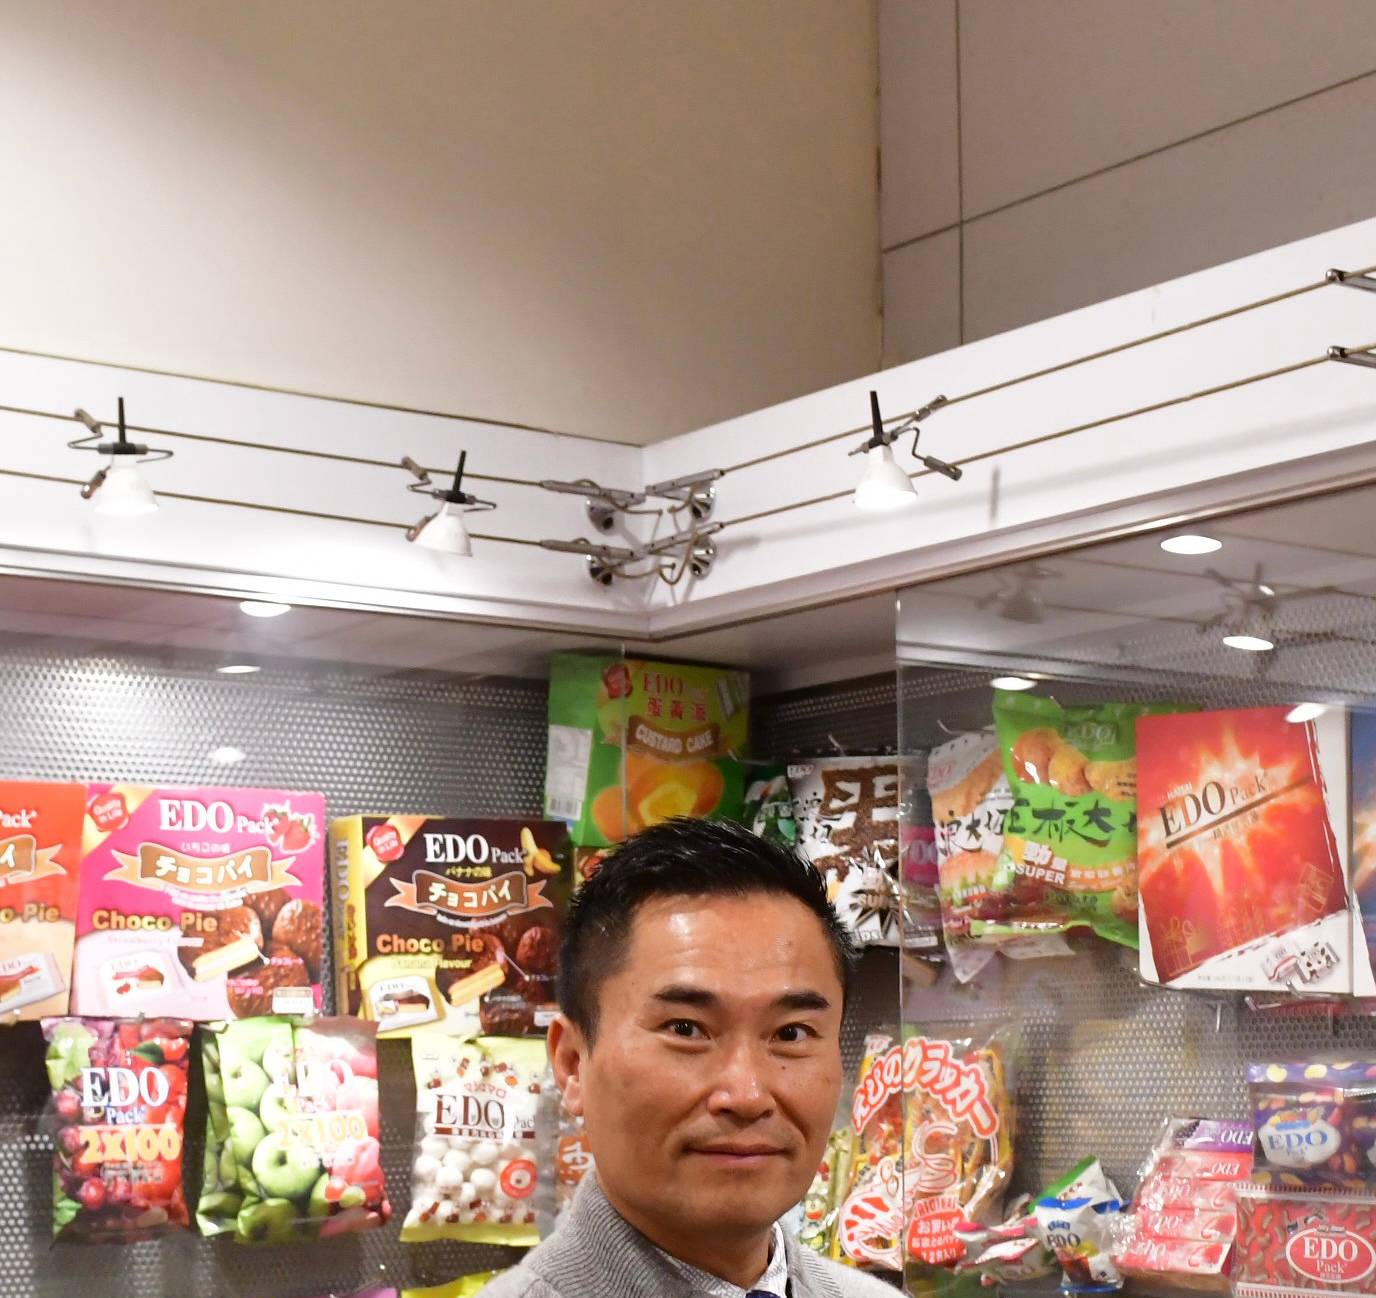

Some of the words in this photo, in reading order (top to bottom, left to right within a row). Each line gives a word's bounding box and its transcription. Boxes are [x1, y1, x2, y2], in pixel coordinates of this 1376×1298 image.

[634, 723, 684, 755] CUSTARD
[685, 729, 715, 754] CAKE
[158, 798, 236, 834] EDO
[237, 814, 274, 834] Pack
[1160, 780, 1226, 839] EDO
[1229, 775, 1267, 806] Pack
[423, 833, 490, 864] EDO
[490, 847, 524, 864] Pack
[1015, 862, 1066, 886] SUPER
[23, 903, 61, 923] Pie
[92, 909, 173, 932] Choco
[180, 911, 218, 932] Pie
[376, 933, 443, 954] Choco
[451, 933, 486, 954] Pie
[80, 1065, 170, 1107] EDO
[435, 1093, 505, 1130] EDO
[1221, 1129, 1254, 1148] EDO
[1267, 1129, 1330, 1151] EDO
[1302, 1238, 1359, 1261] EDO
[1315, 1259, 1345, 1275] Pack
